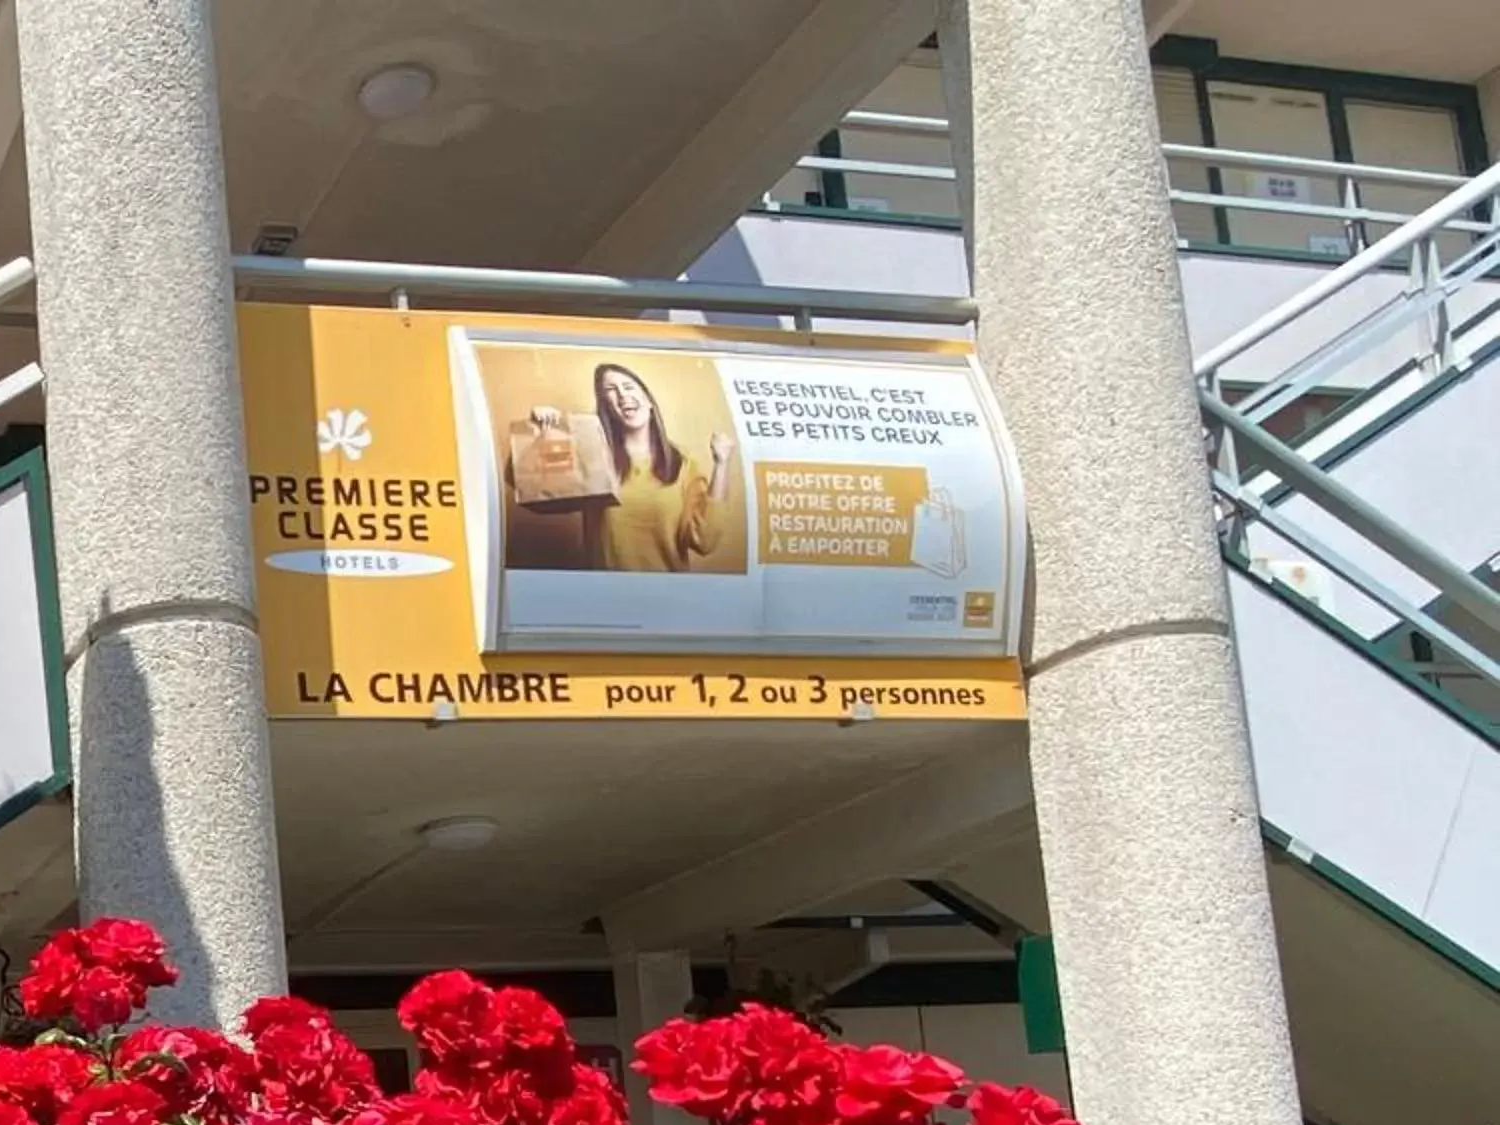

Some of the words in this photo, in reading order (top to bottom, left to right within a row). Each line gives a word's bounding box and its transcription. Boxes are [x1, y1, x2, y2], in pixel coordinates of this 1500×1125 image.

[871, 388, 925, 404] C'EST
[741, 401, 769, 416] DE
[776, 401, 872, 421] POUVOIR
[877, 408, 979, 427] COMBLER
[746, 421, 785, 436] LES
[792, 423, 865, 441] PETITS
[871, 427, 943, 445] CREUX
[249, 475, 457, 507] PREMIERE
[766, 471, 854, 489] PROFITEZ
[860, 475, 884, 491] DE
[767, 493, 833, 510] NOTRE
[837, 495, 896, 513] OFFRE
[278, 511, 430, 541] CLASSE
[770, 514, 908, 534] RESTAURATION
[769, 535, 782, 554] À
[788, 538, 889, 556] EMPORTER
[320, 554, 400, 571] HOTELS
[297, 672, 353, 703] LA
[369, 672, 571, 703] CHAMBRE
[605, 682, 676, 708] pour
[691, 674, 716, 707] 1,
[728, 673, 749, 703] 2
[761, 684, 797, 704] ou
[808, 675, 827, 703] 3
[839, 684, 986, 709] personnes
